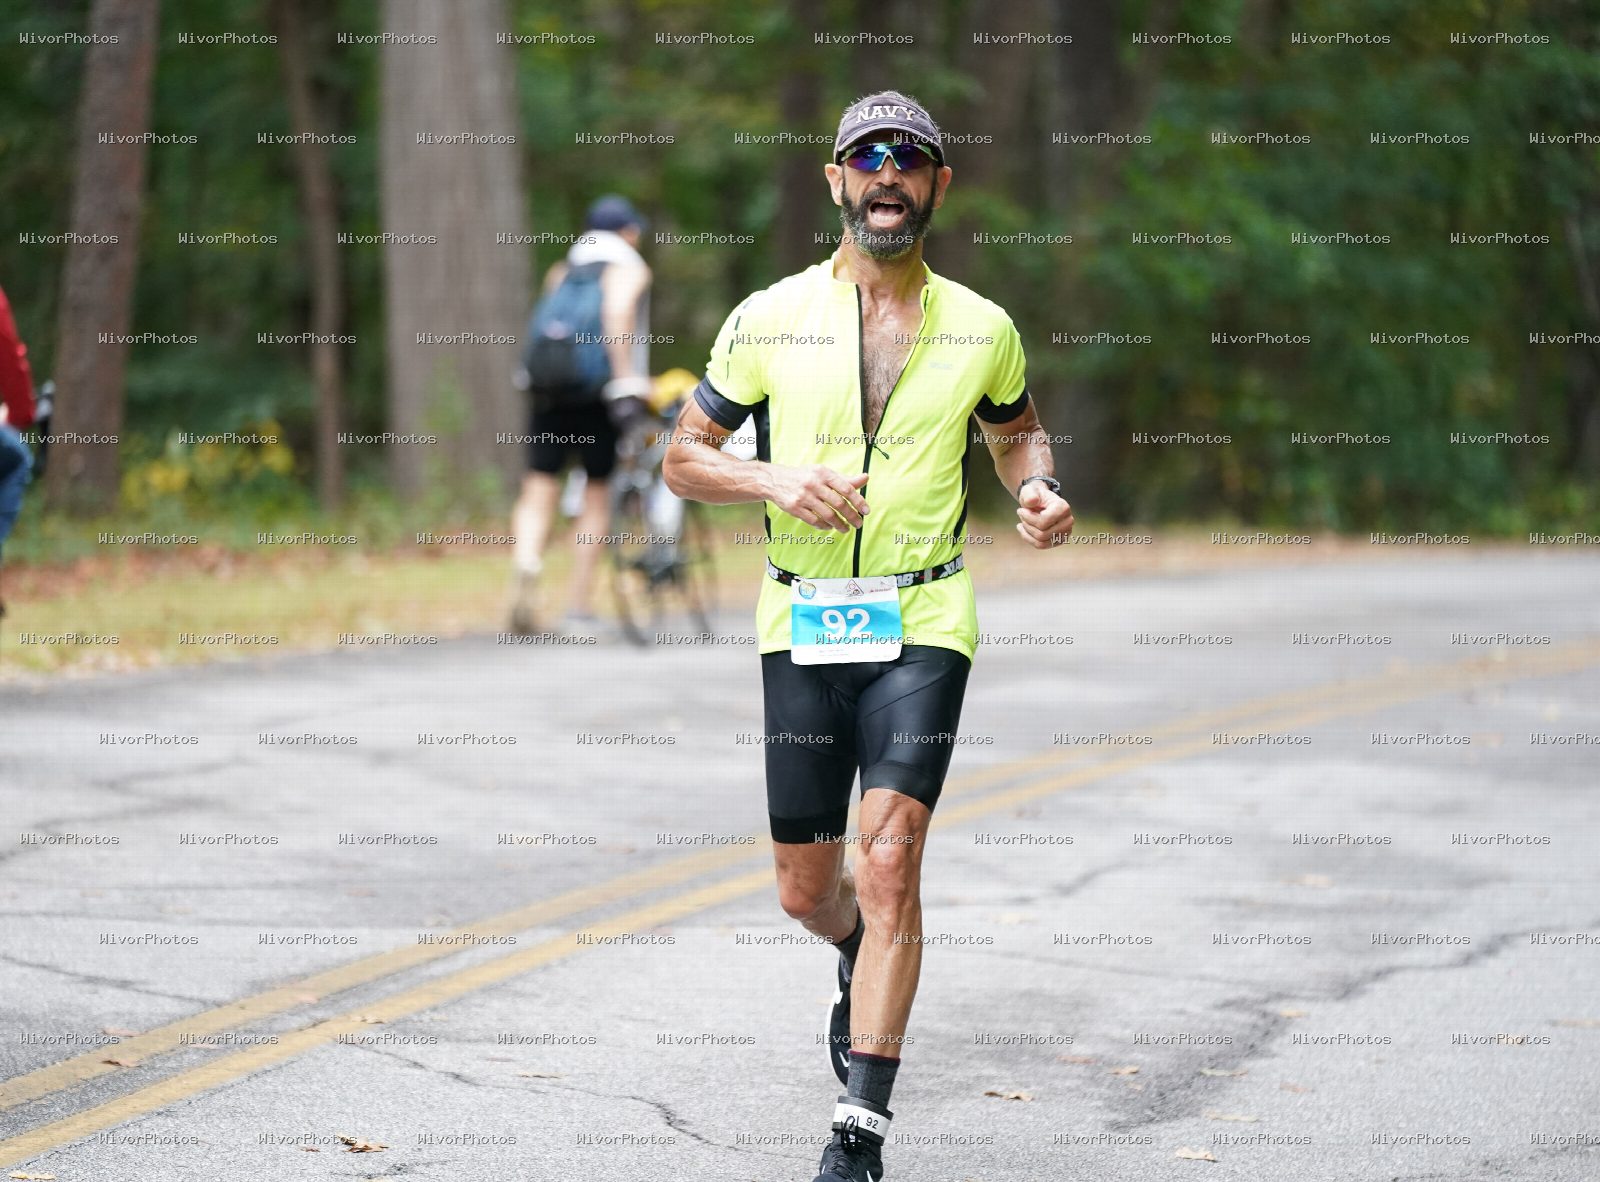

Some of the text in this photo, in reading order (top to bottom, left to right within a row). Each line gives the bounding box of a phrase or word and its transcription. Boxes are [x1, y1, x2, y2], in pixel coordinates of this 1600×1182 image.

[856, 105, 916, 124] NAVY
[821, 608, 872, 641] 92
[865, 1116, 879, 1130] 92
